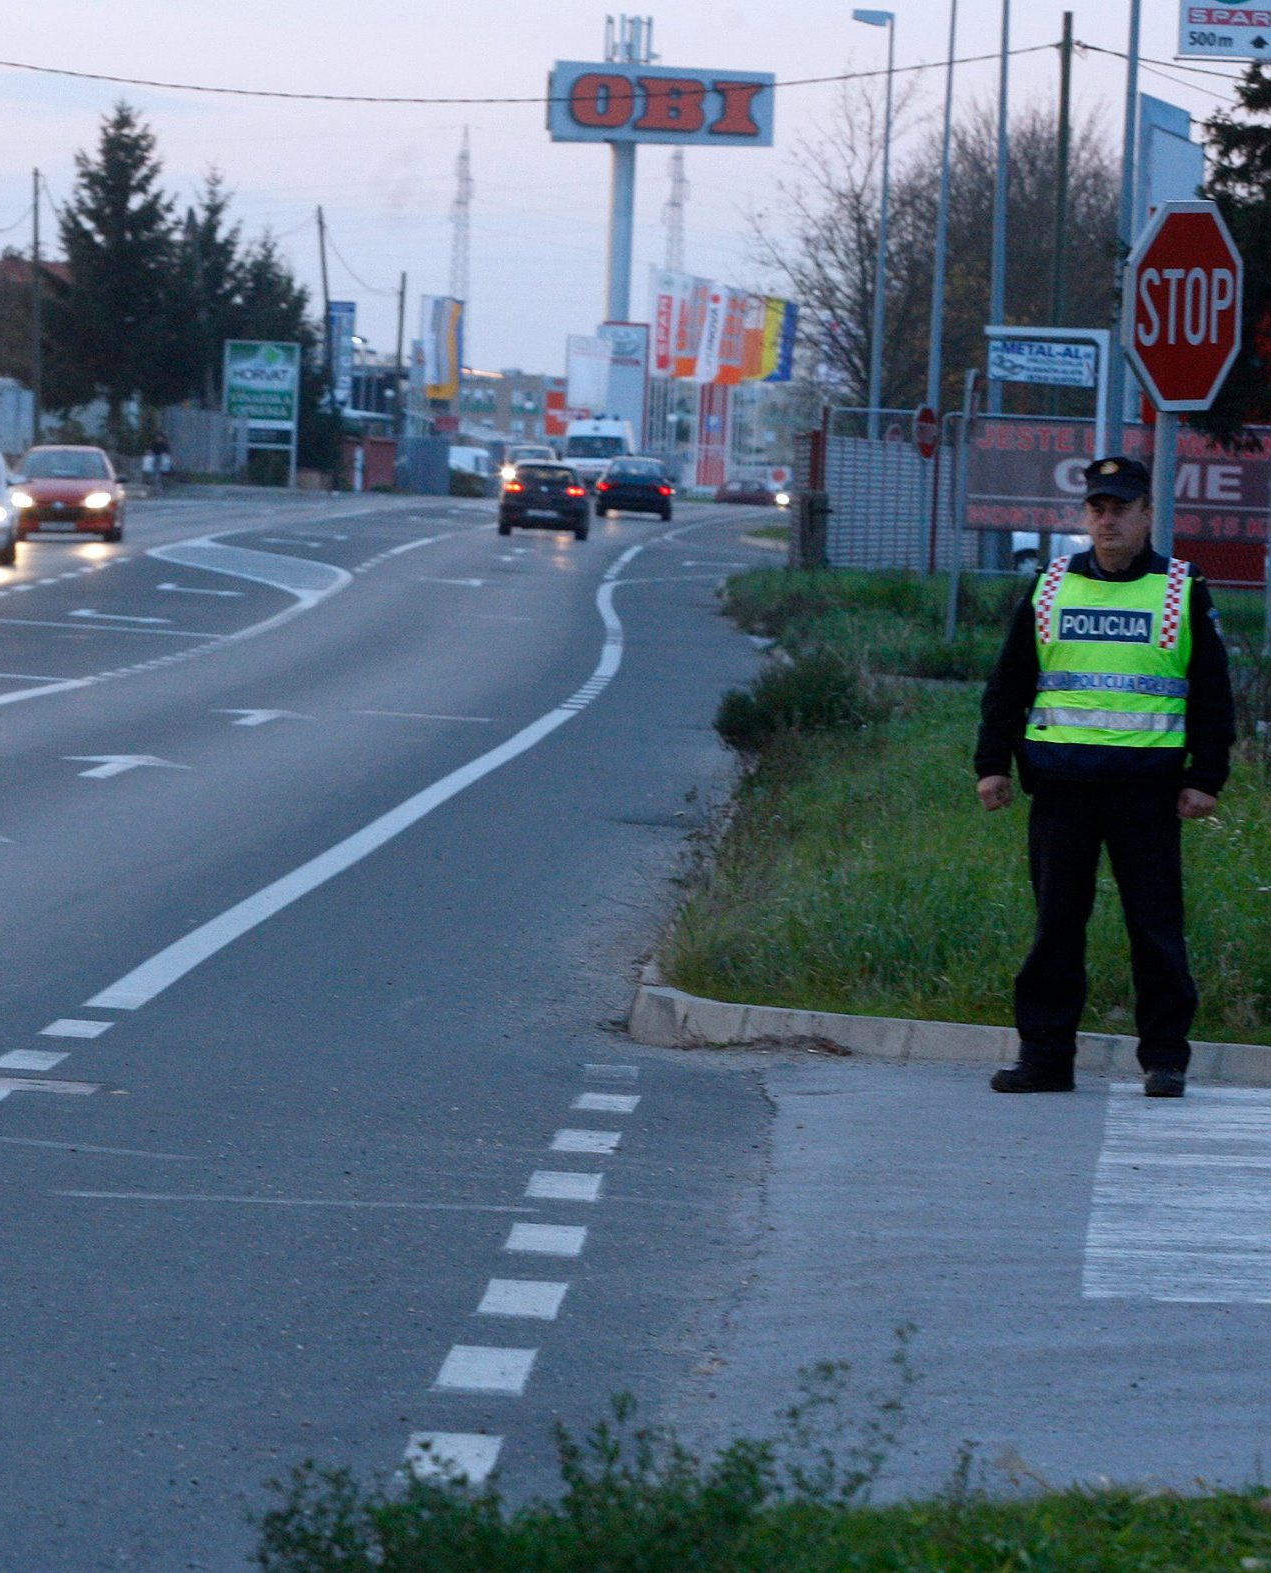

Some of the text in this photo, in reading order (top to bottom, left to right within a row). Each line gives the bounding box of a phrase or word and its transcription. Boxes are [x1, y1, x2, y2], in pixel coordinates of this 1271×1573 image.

[1190, 9, 1270, 26] SPAR
[1189, 31, 1216, 46] 500
[570, 73, 763, 136] OBI
[1137, 267, 1234, 347] STOP
[977, 424, 1074, 451] JESTE
[1053, 457, 1243, 500] GME
[1061, 614, 1149, 637] POLICIJA
